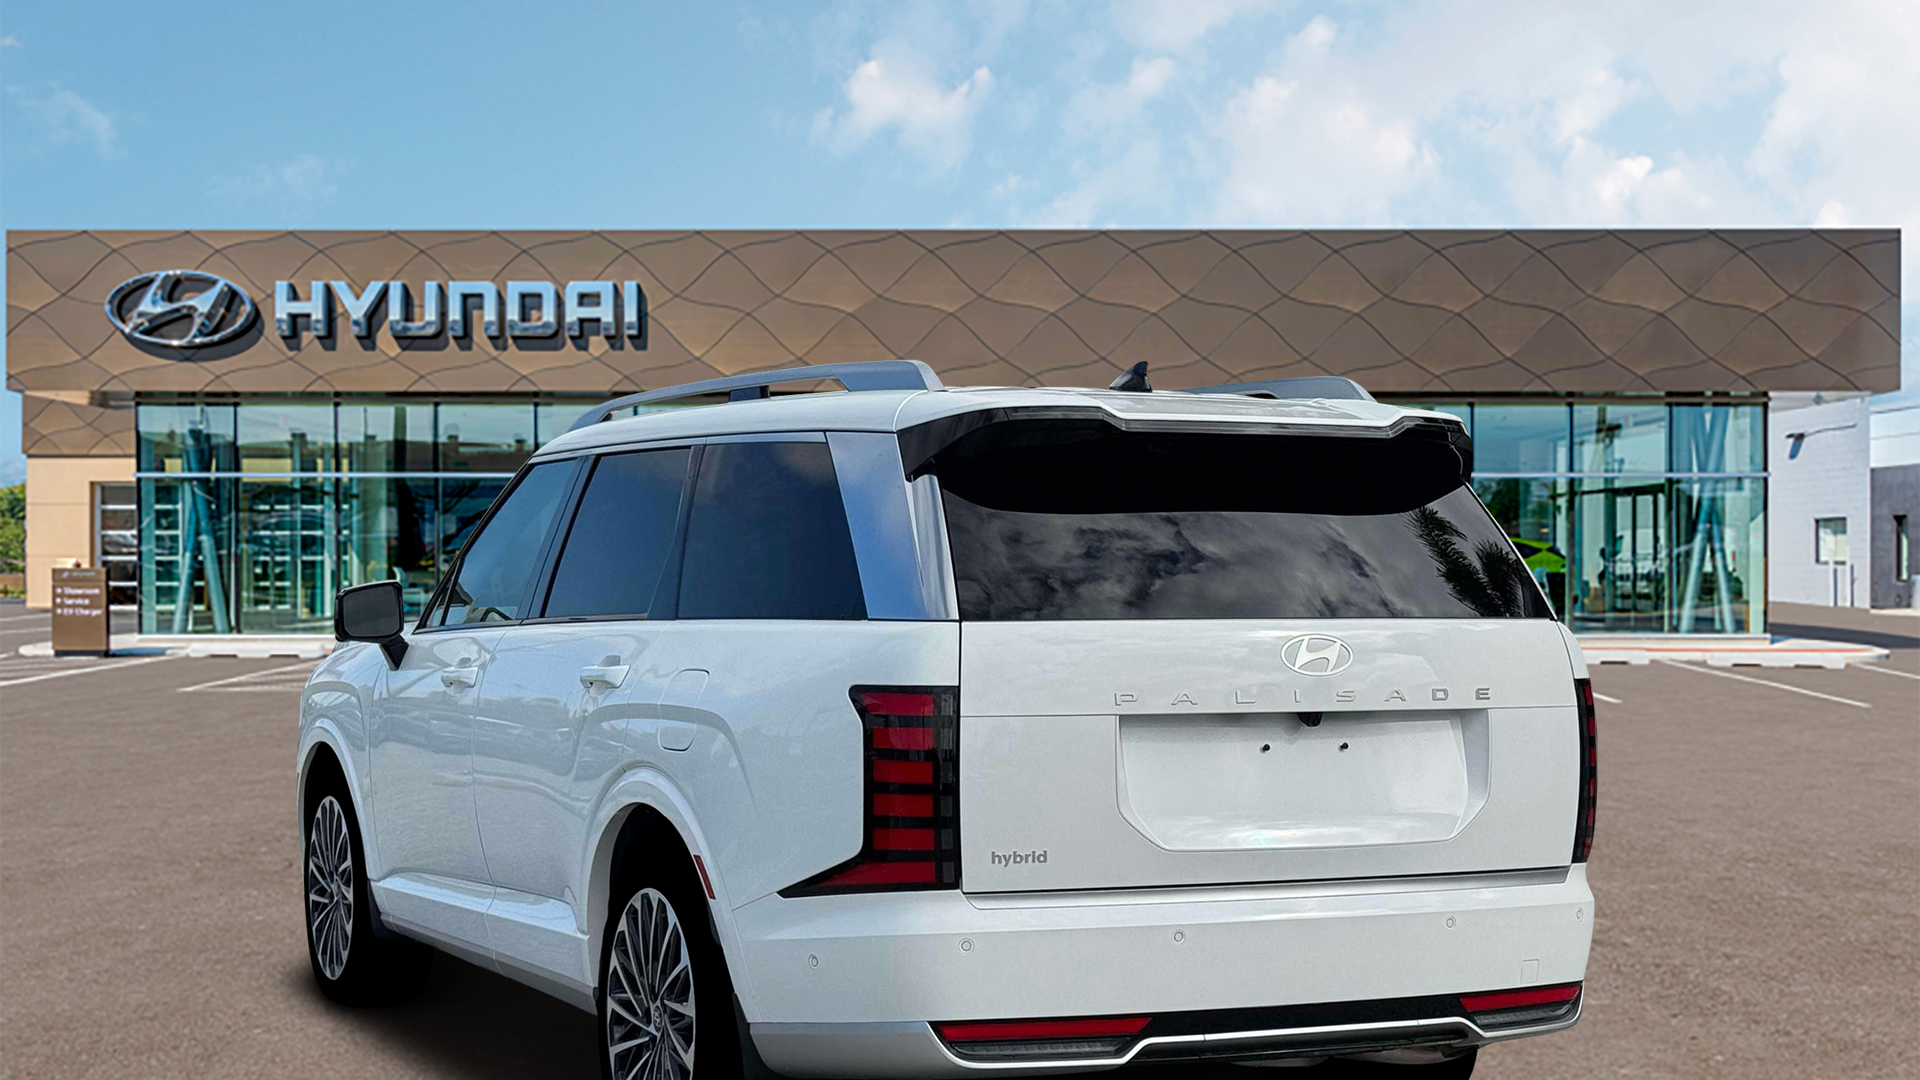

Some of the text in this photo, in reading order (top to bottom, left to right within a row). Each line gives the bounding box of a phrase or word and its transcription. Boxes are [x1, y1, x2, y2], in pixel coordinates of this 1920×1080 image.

[274, 280, 643, 344] HYUNDAI
[1114, 687, 1491, 706] PALISADE
[991, 850, 1048, 868] hybrid
